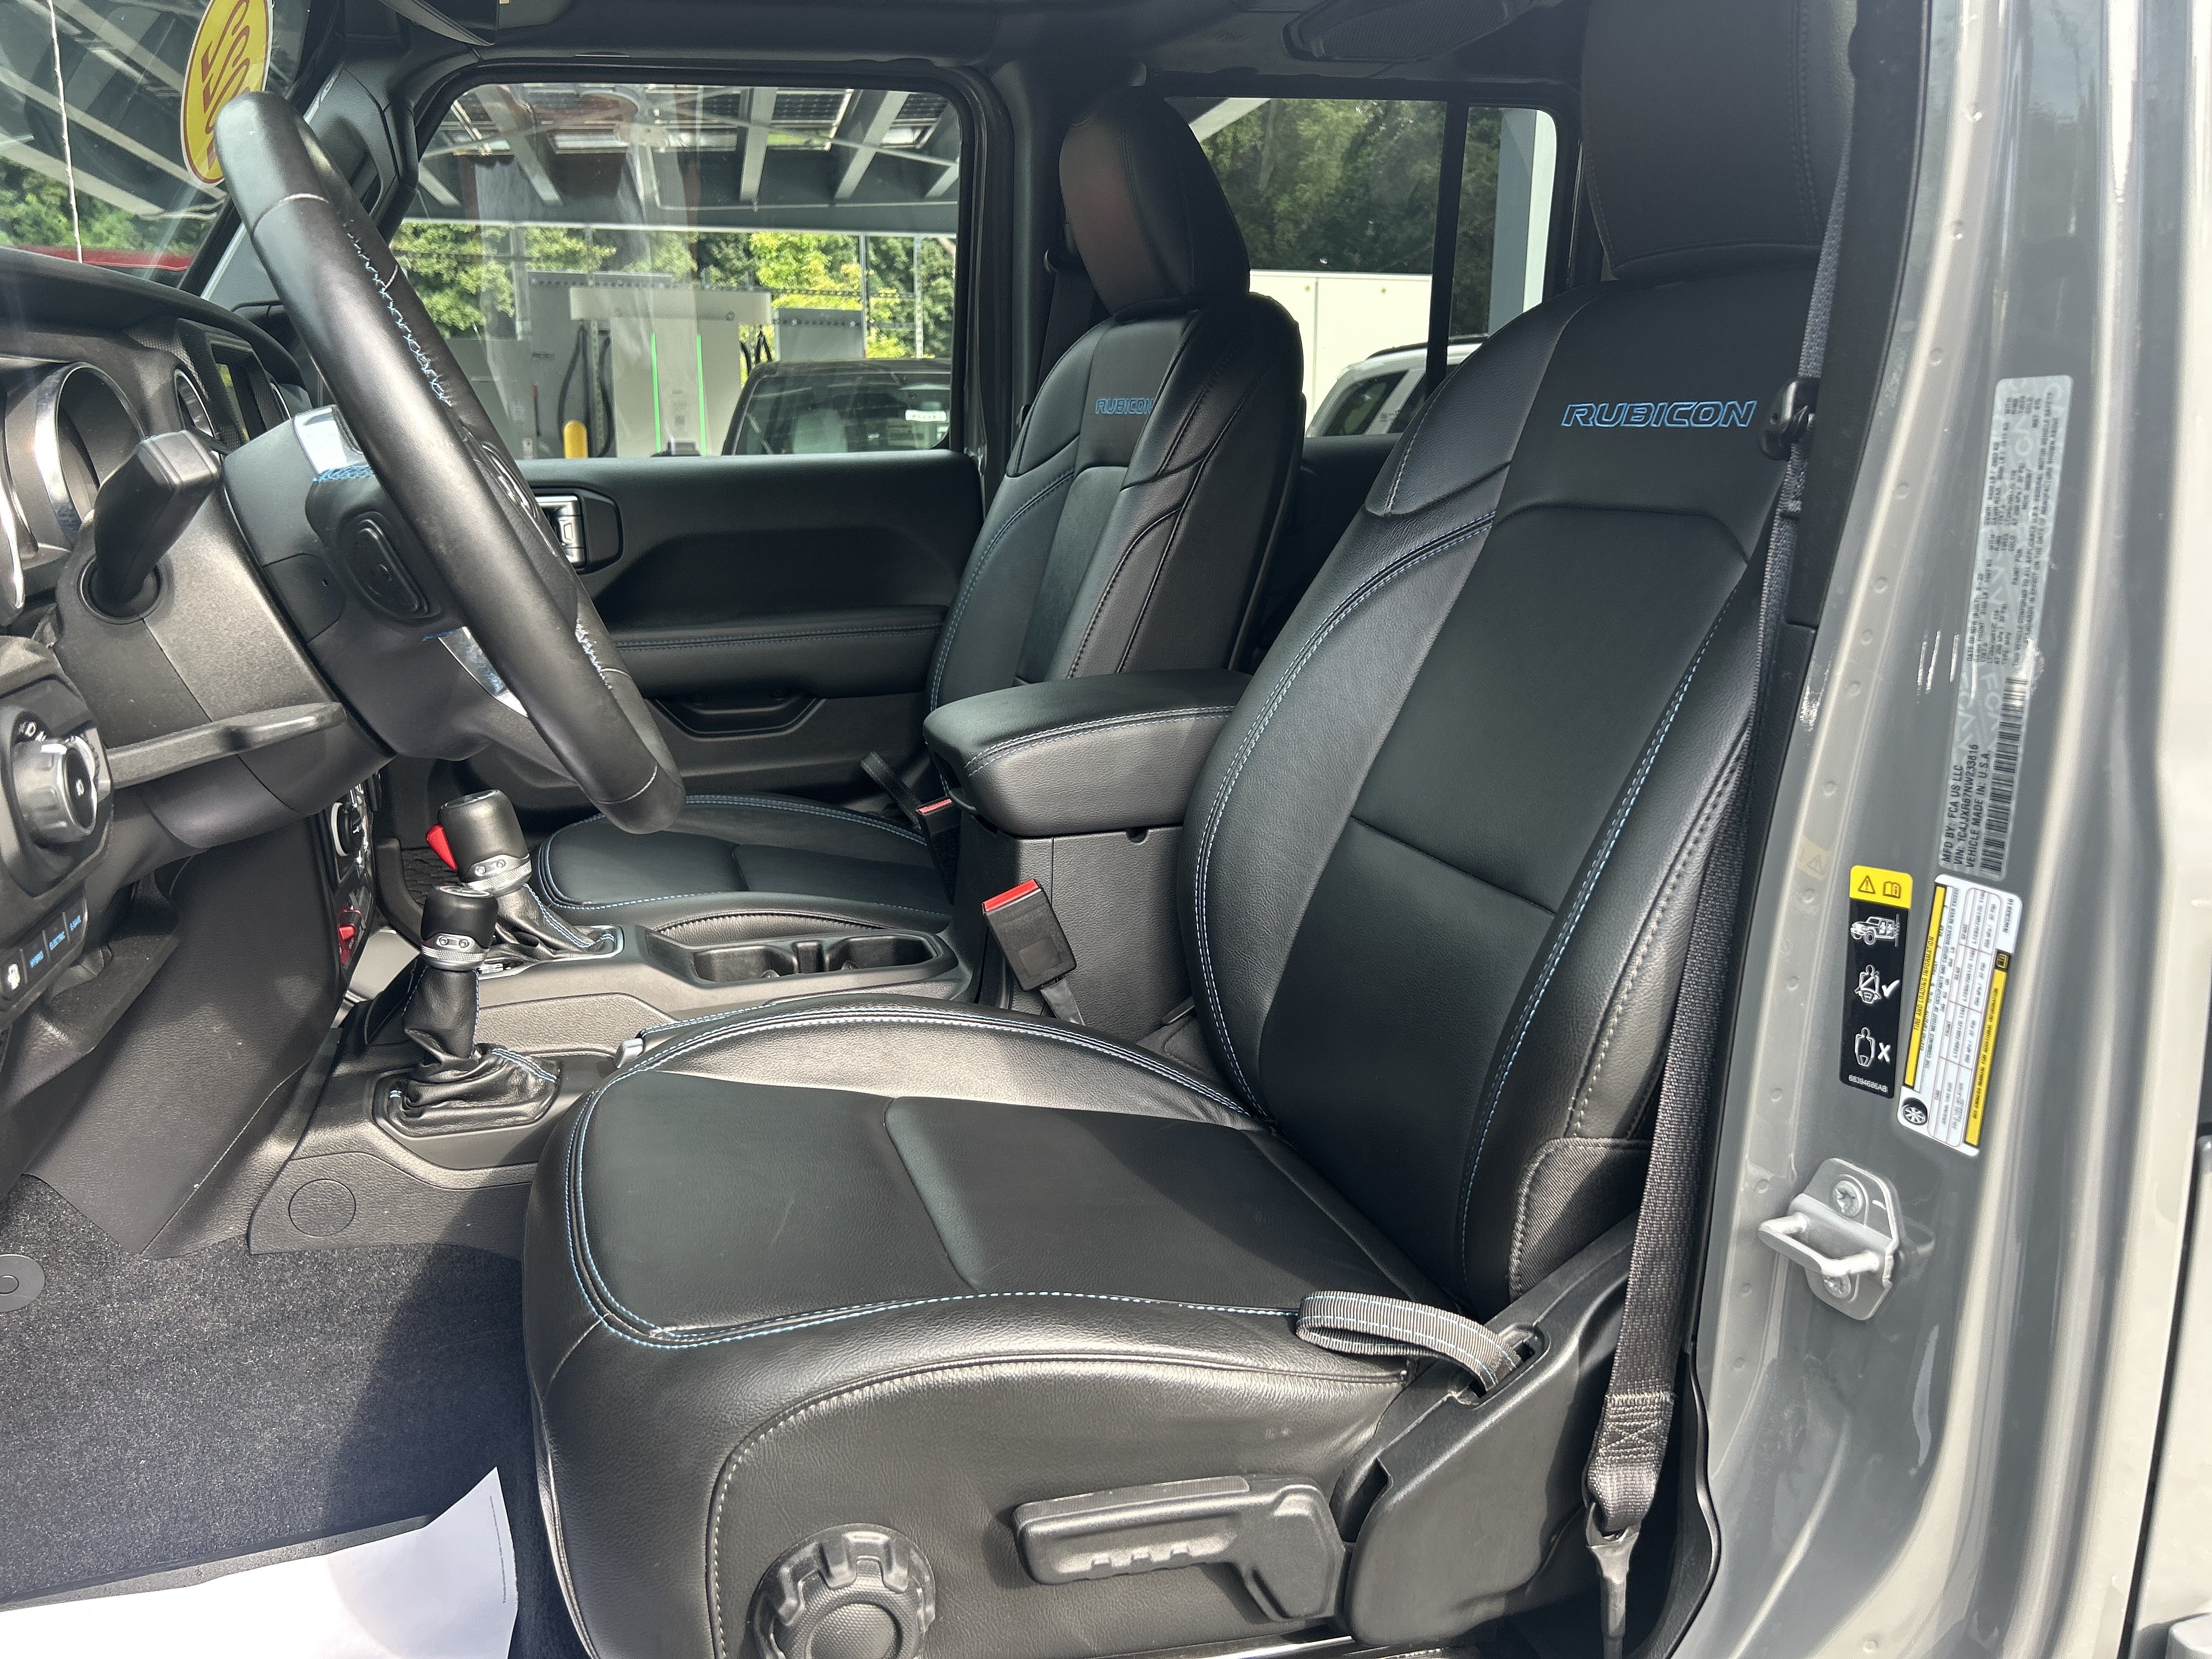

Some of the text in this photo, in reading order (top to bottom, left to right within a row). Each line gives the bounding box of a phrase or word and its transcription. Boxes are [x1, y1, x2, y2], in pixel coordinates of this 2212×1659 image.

[1561, 400, 1757, 427] RUBICON
[1951, 764, 1963, 781] LLC
[1949, 784, 1960, 797] US
[1975, 781, 1985, 795] IN:
[1947, 800, 1958, 818] FCA
[1971, 799, 1983, 826] MADE
[1942, 841, 1953, 862] MFD
[1953, 845, 1965, 865] VIN:
[1965, 829, 1979, 868] VEHICLE
[1922, 935, 1934, 977] INFORMATION
[1918, 977, 1927, 1003] LOADING
